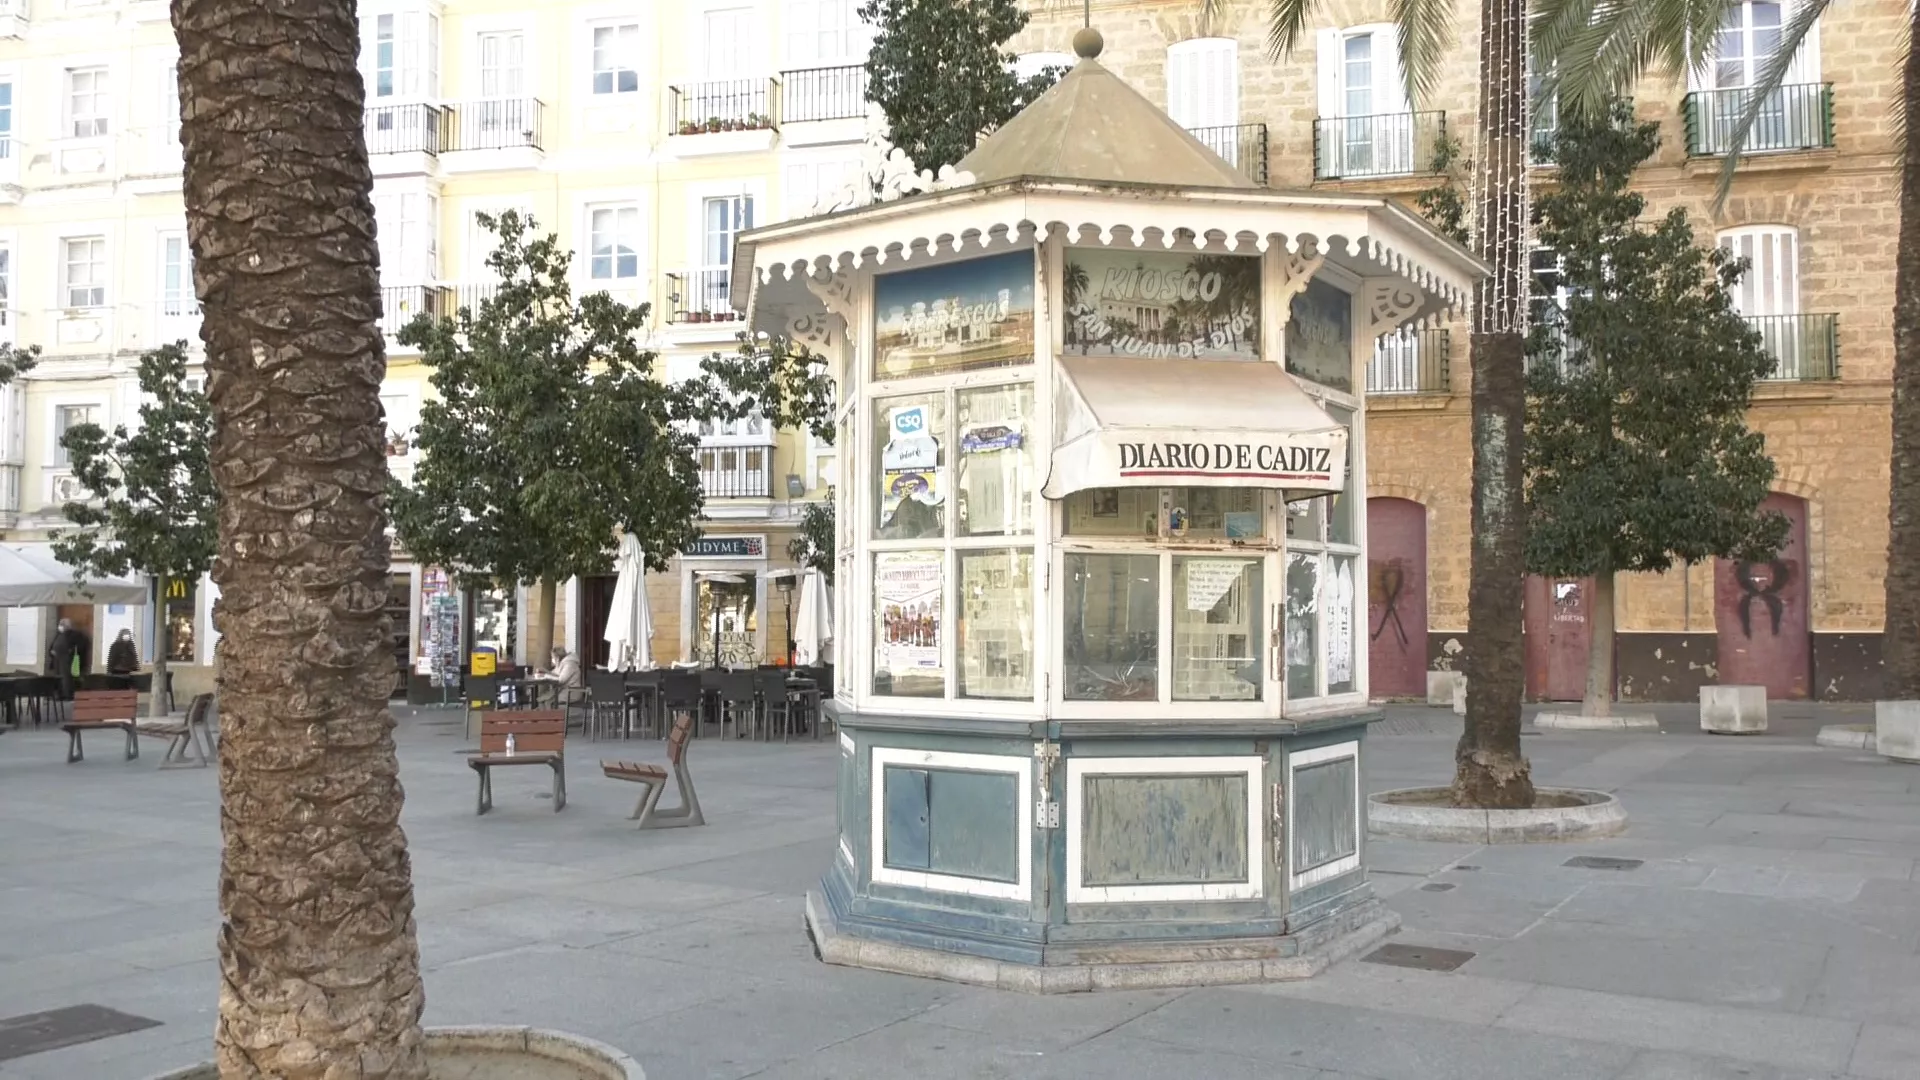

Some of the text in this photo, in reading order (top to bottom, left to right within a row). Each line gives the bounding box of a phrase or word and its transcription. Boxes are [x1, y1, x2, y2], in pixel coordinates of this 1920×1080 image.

[1101, 267, 1222, 302] KIOSCO
[1069, 303, 1254, 359] SAN JUAN DE DIOS
[897, 414, 921, 428] CSQ
[1118, 443, 1331, 472] DIARIO DE CADIZ
[687, 542, 740, 553] DIDYME
